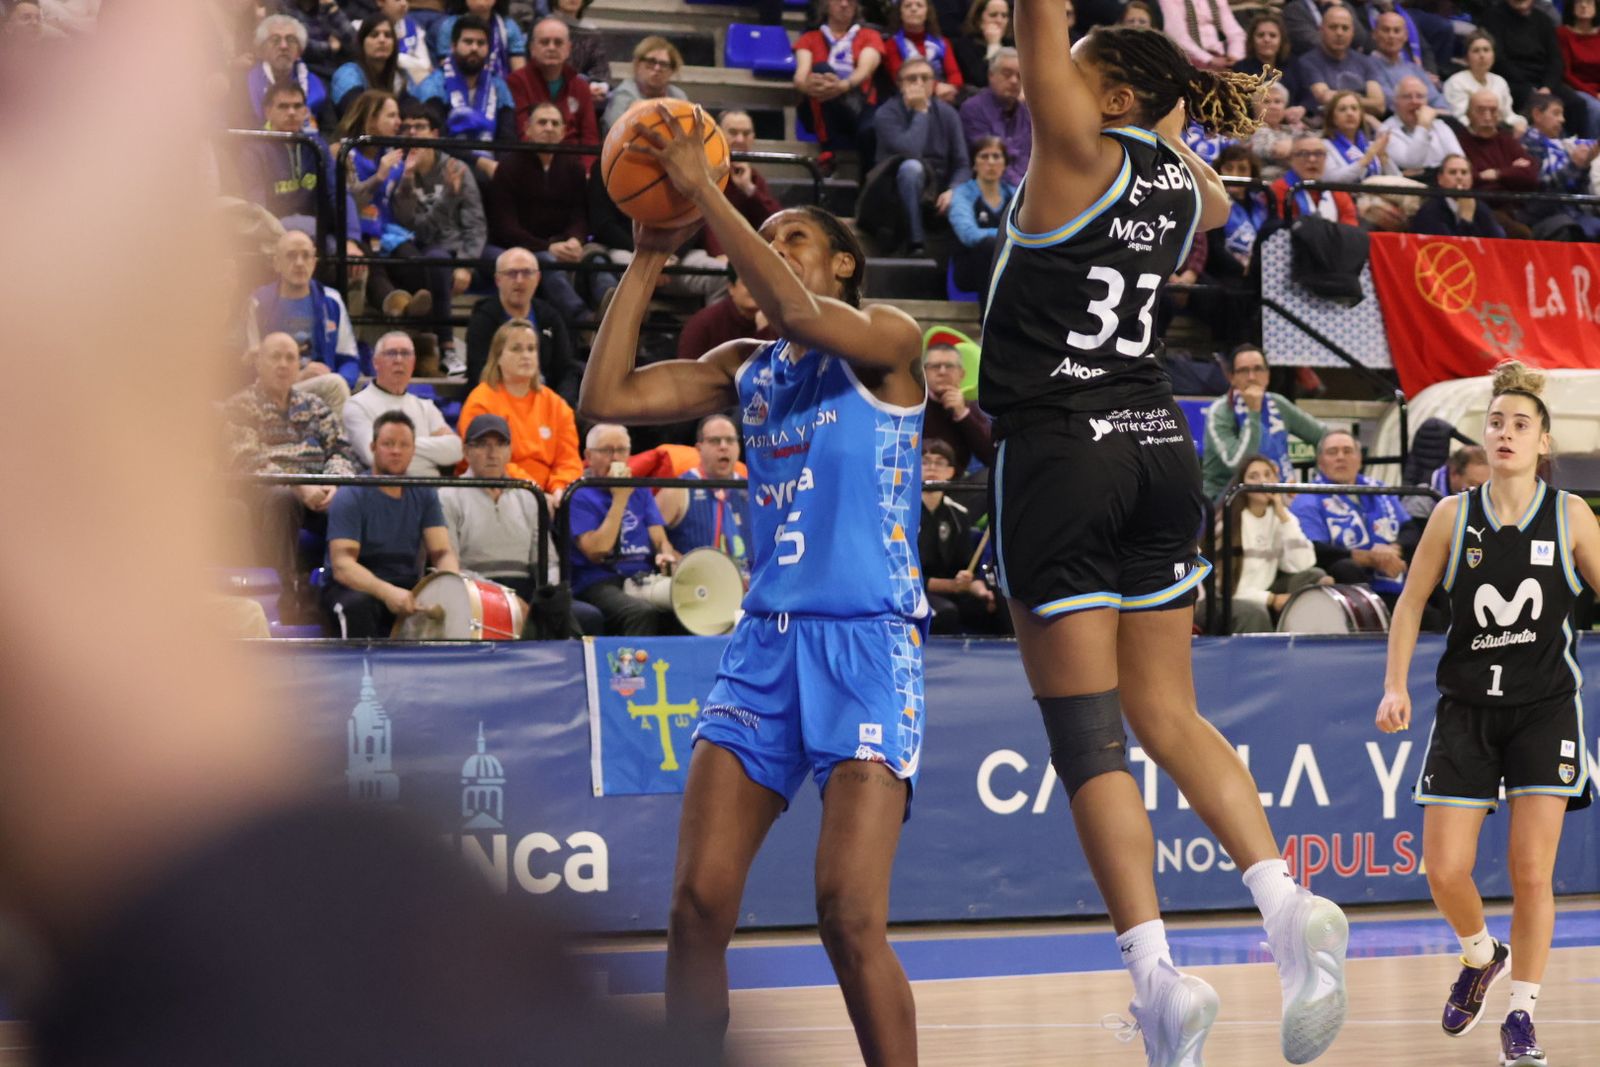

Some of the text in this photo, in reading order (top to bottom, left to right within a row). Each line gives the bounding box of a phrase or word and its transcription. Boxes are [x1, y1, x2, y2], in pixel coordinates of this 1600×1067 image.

[1066, 266, 1162, 357] 33
[1525, 260, 1600, 324] La R
[1486, 664, 1504, 696] 1
[1365, 741, 1412, 819] Y
[1281, 831, 1427, 889] MPULS
